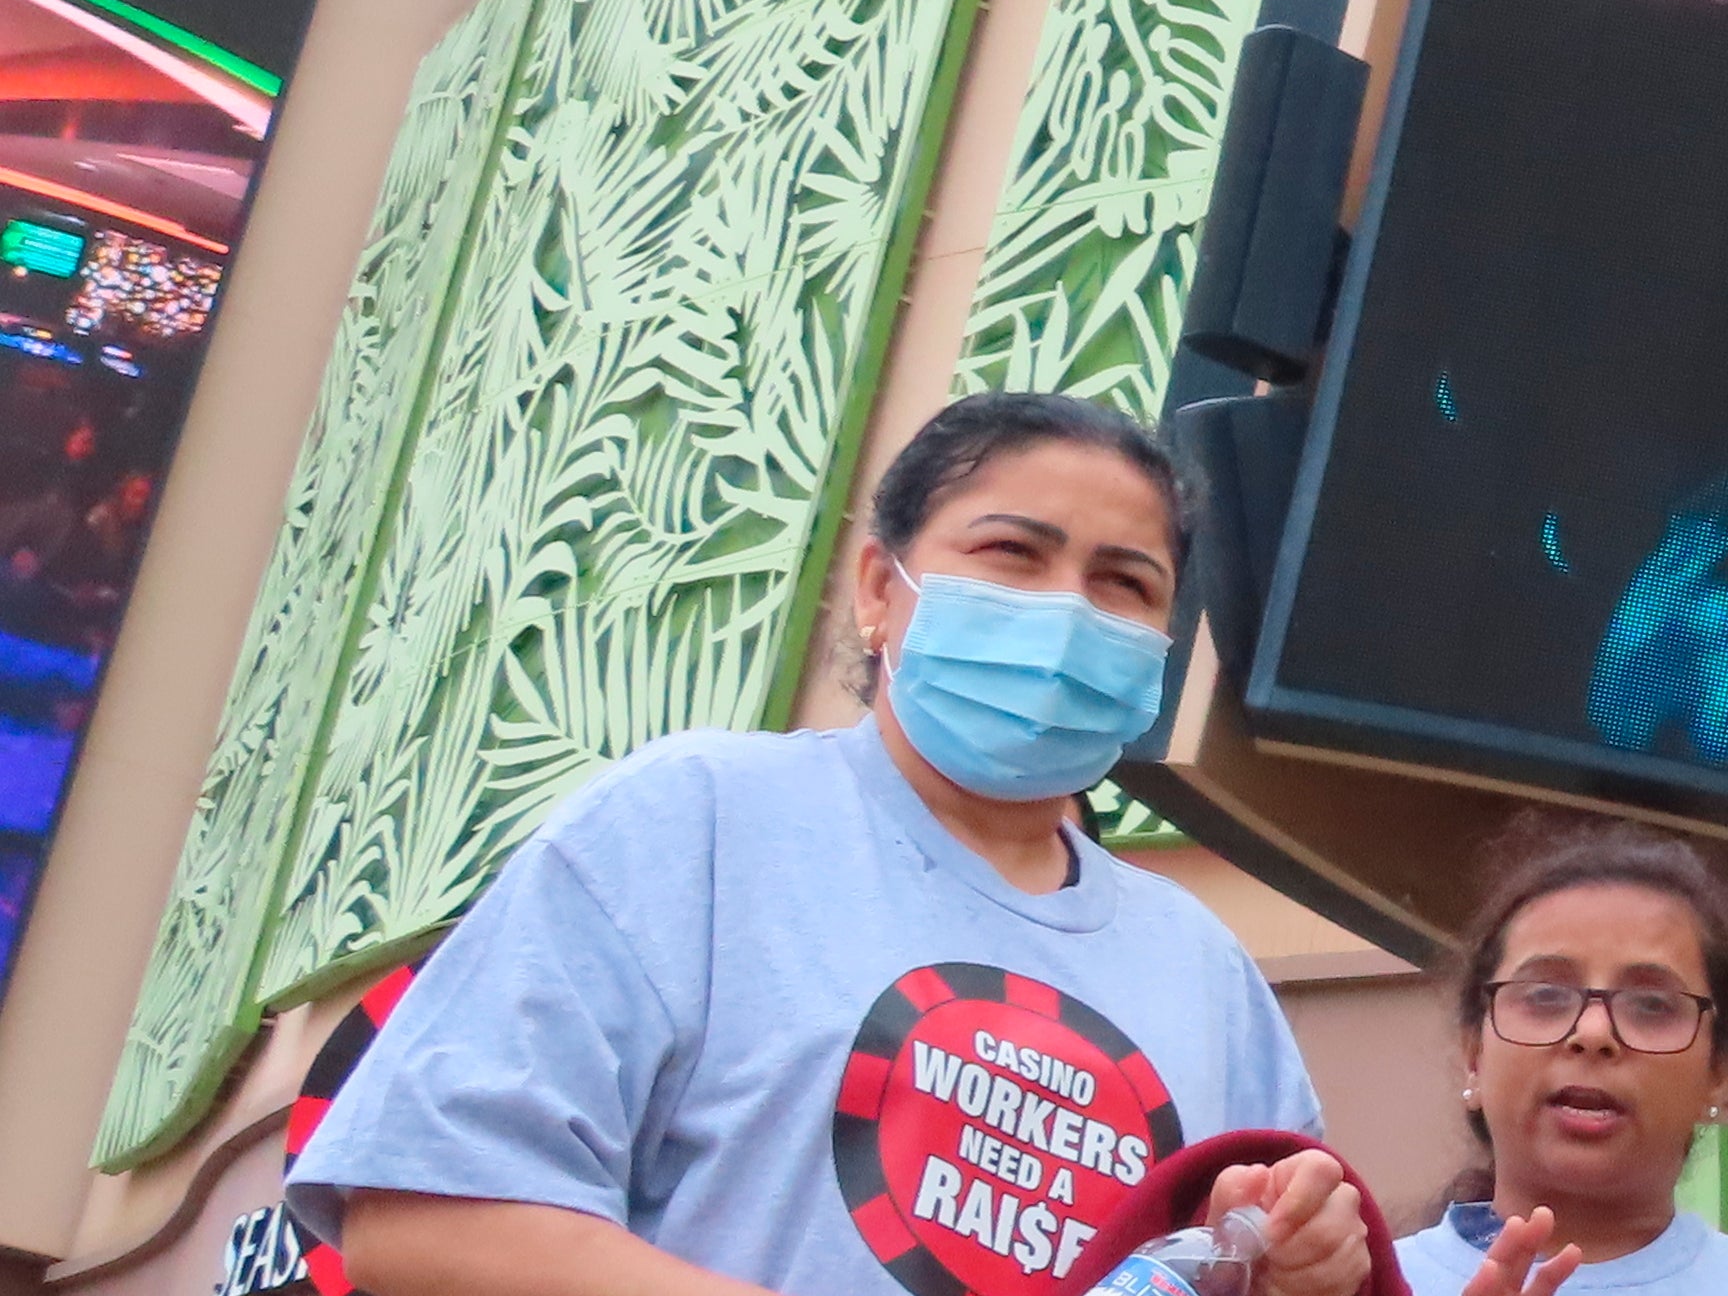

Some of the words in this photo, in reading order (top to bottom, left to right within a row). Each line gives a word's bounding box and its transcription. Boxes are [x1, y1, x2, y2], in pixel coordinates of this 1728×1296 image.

[974, 1030, 1096, 1106] CASINO
[913, 1040, 1148, 1186] WORKERS
[958, 1124, 1043, 1191] NEED
[1048, 1167, 1075, 1205] A
